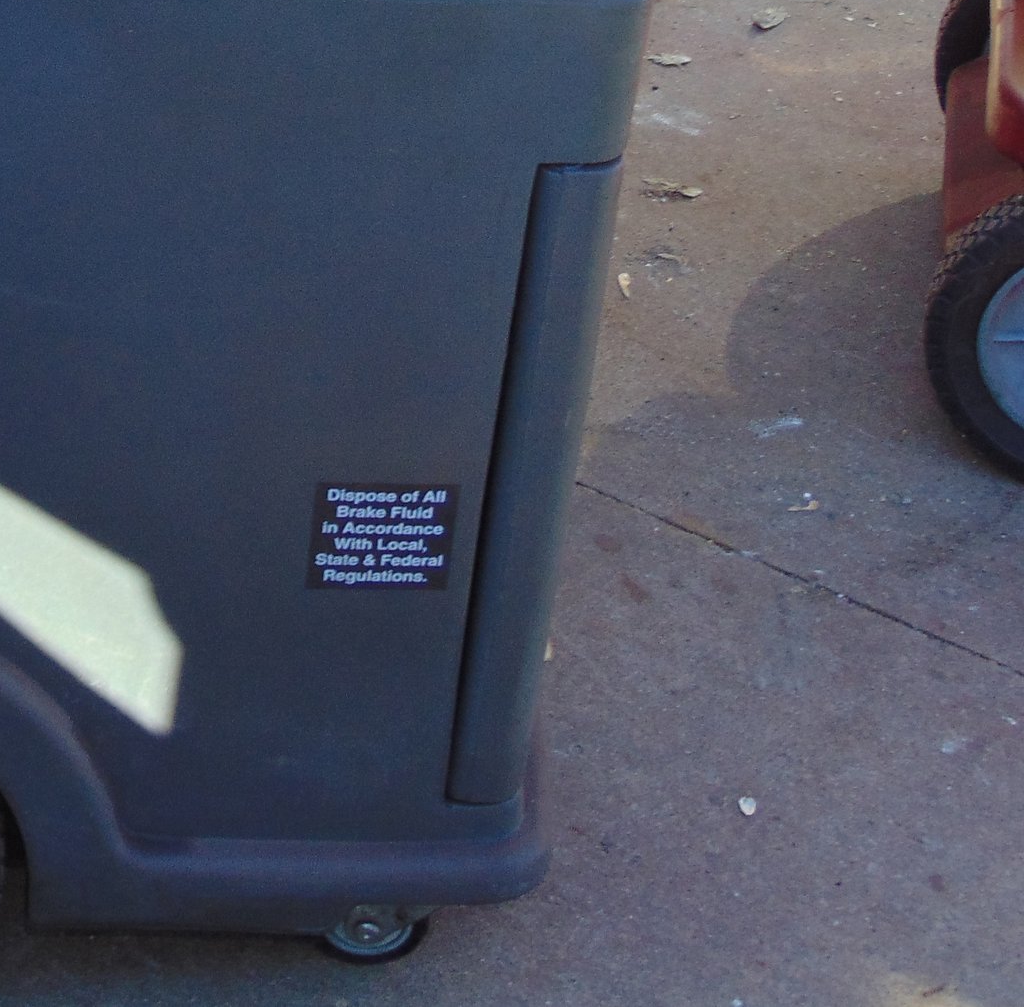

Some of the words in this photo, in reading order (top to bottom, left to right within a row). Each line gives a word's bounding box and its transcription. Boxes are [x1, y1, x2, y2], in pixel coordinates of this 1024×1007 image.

[327, 488, 397, 504] Dispose
[401, 490, 420, 503] of
[422, 490, 447, 503] All
[336, 505, 386, 518] Brake
[390, 506, 434, 519] Fluid
[342, 522, 444, 535] Accordance
[334, 537, 373, 550] With
[377, 539, 427, 553] Local,
[315, 553, 359, 566] State
[362, 554, 375, 566] &
[380, 554, 444, 567] Federal
[323, 569, 427, 585] Regulations.
